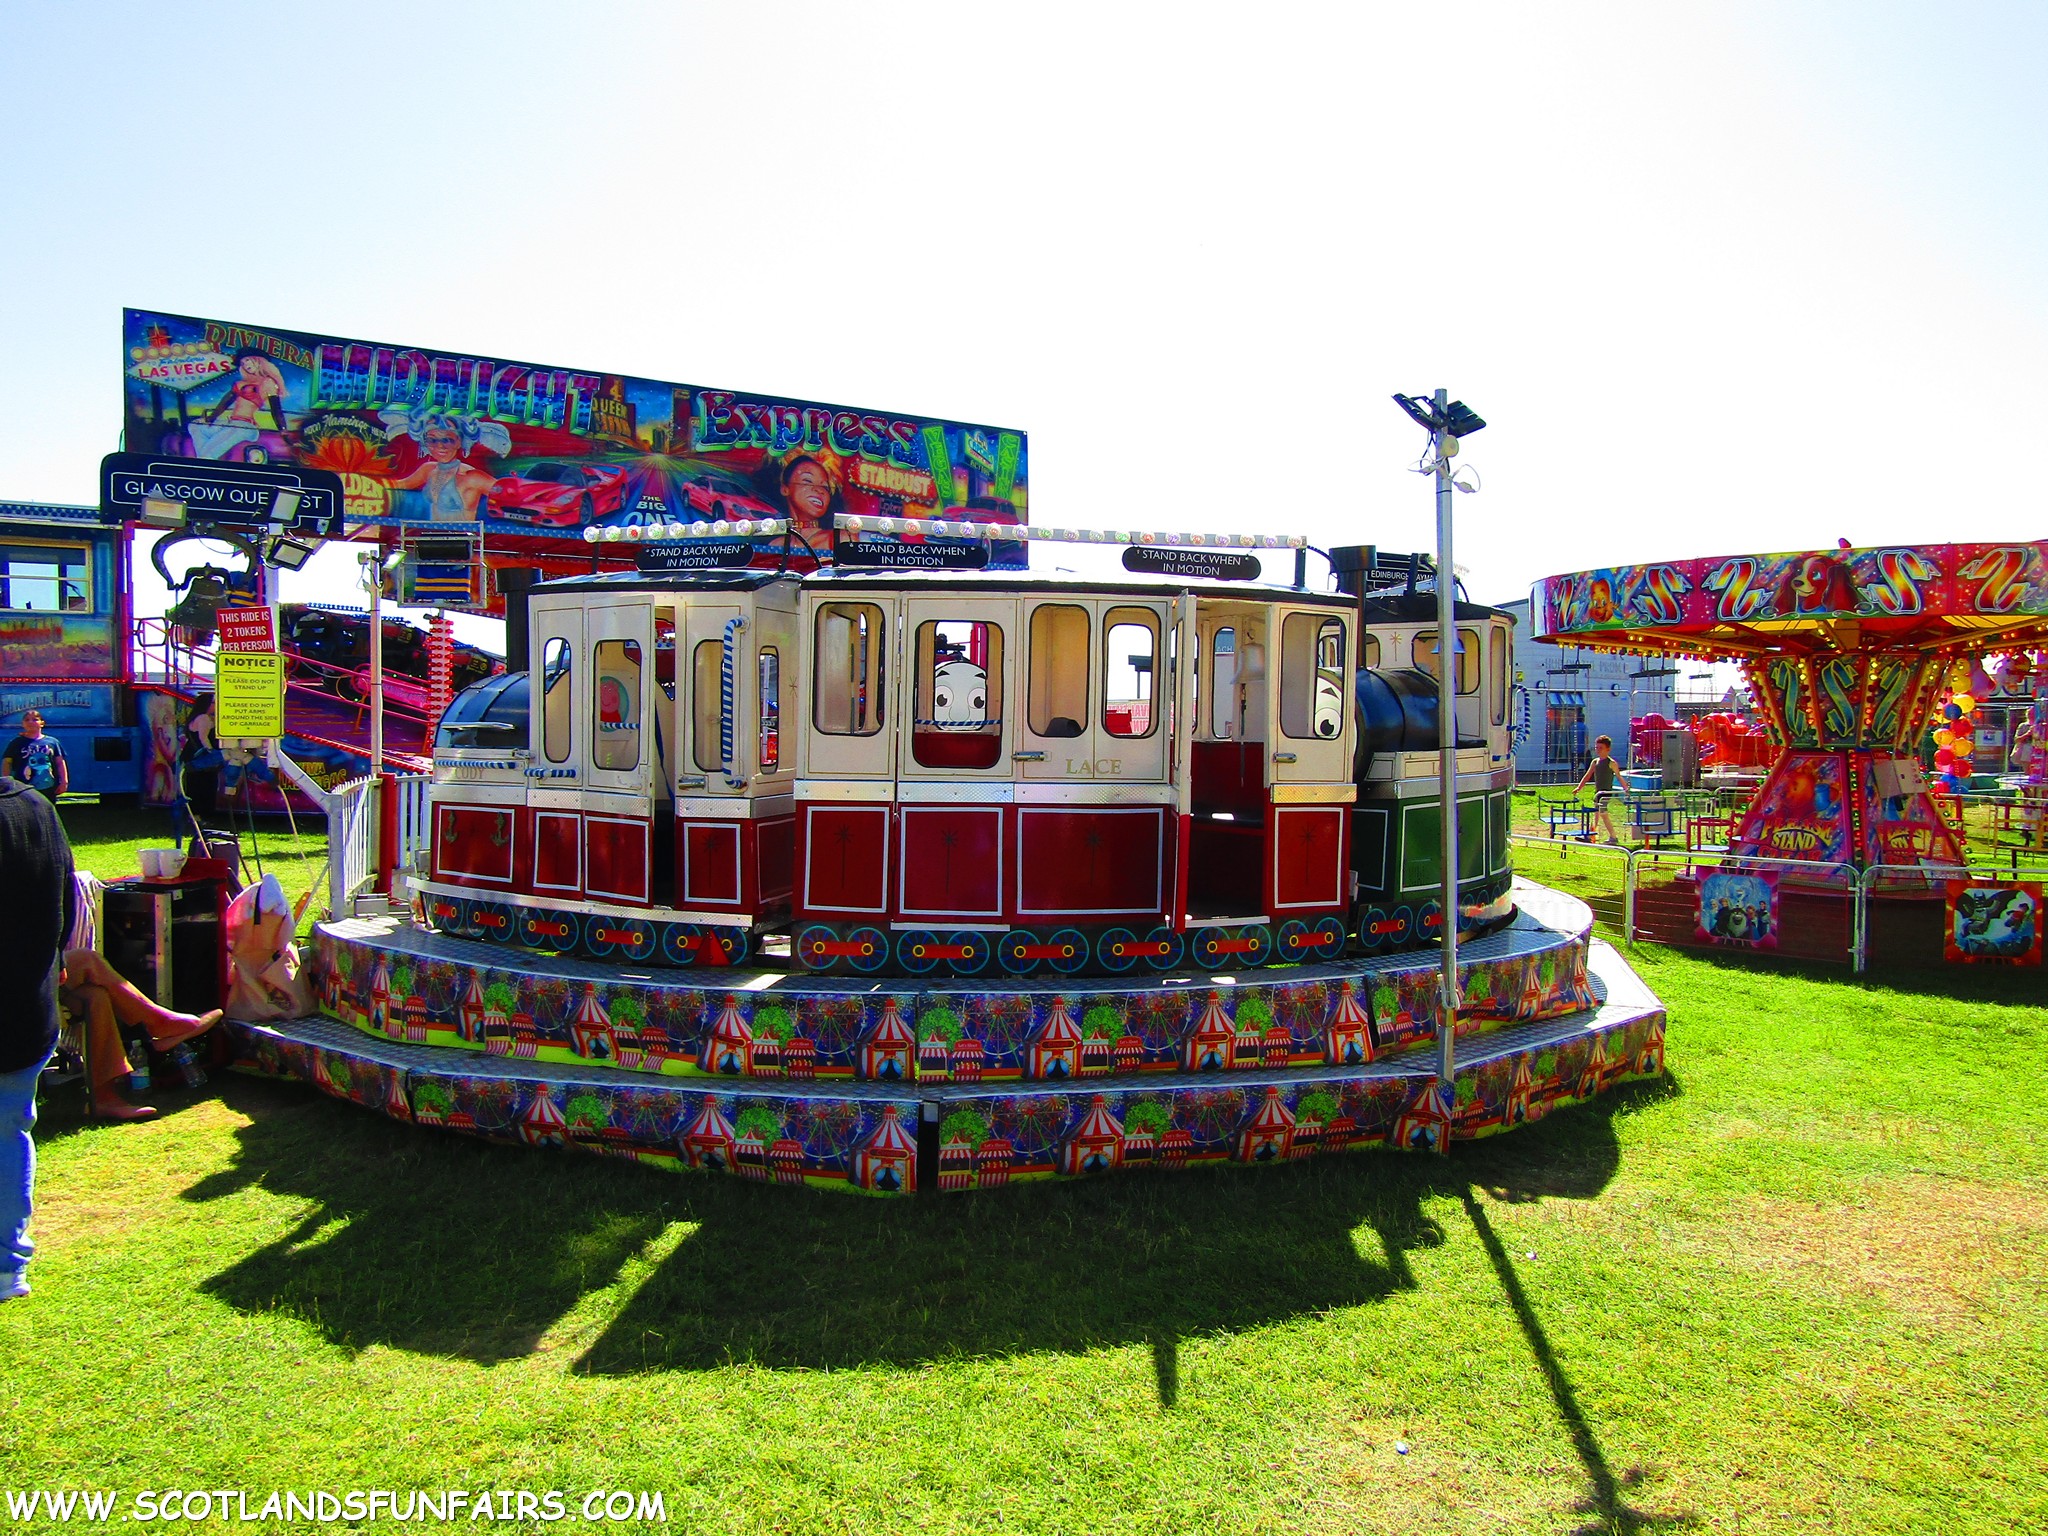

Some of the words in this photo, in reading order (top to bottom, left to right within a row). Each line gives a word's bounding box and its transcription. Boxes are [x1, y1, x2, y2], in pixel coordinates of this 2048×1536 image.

[204, 322, 315, 371] RIVIERA
[138, 366, 169, 379] LAS
[174, 360, 232, 376] VEGAS
[312, 343, 600, 434] MIDNIGHT
[696, 391, 921, 469] Express
[858, 463, 931, 496] STARDUST
[636, 501, 667, 511] BIG
[650, 547, 681, 557] STAND
[683, 546, 708, 556] BACK
[709, 545, 740, 554] WHEN
[858, 543, 896, 554] STAND
[898, 545, 928, 555] BACK
[930, 546, 966, 556] WHEN
[666, 558, 677, 567] IN
[679, 557, 719, 567] MOTION
[881, 555, 894, 564] IN
[900, 556, 944, 566] MOTION
[1142, 549, 1177, 560] STAND
[1179, 552, 1207, 563] BACK
[1208, 554, 1241, 566] WHEN
[1163, 562, 1174, 572] IN
[1177, 564, 1220, 576] MOTION
[220, 613, 240, 623] THIS
[241, 611, 260, 622] RIDE
[261, 611, 270, 621] IS
[226, 627, 233, 638] 2
[234, 626, 267, 637] TOKENS
[223, 642, 240, 651] PER
[241, 640, 273, 651] PERSON
[224, 657, 276, 668] NOTICE
[1065, 758, 1122, 775] LACE
[455, 767, 485, 780] CODY
[1770, 830, 1818, 851] STAND
